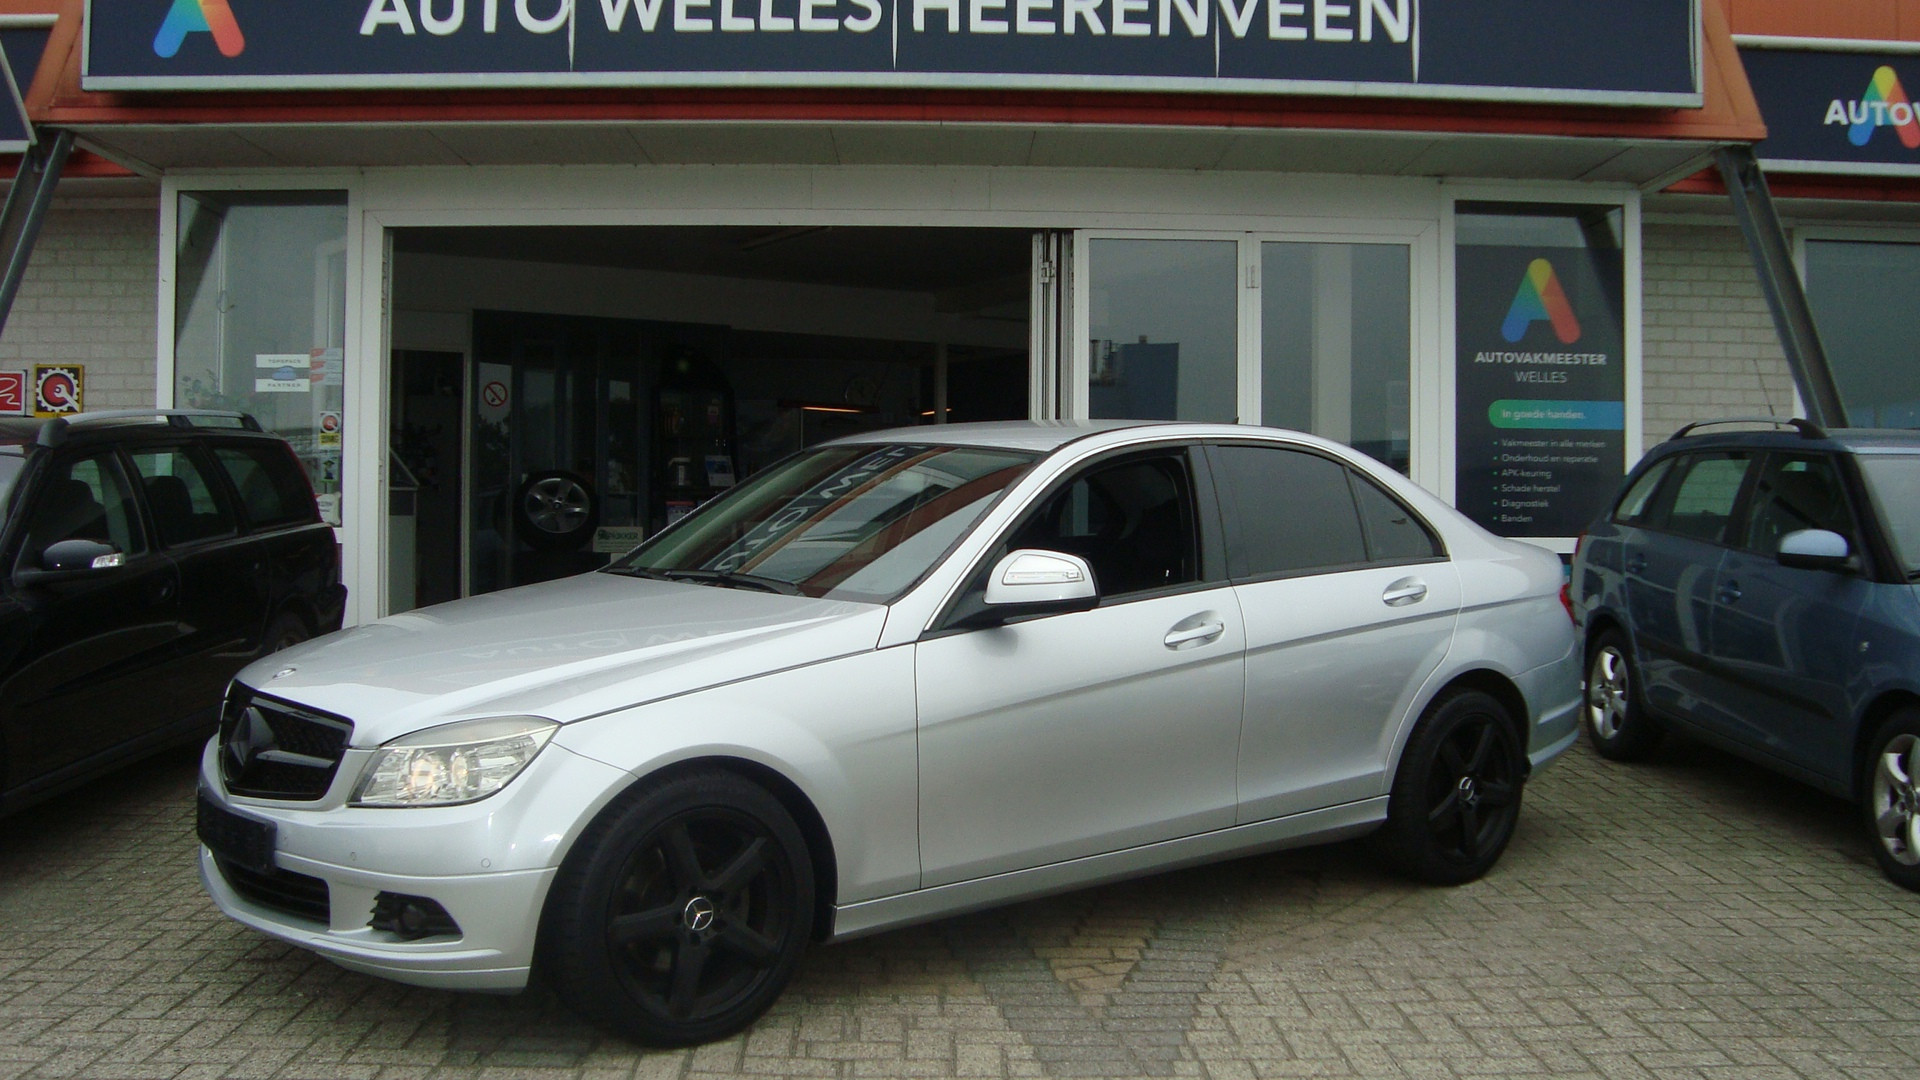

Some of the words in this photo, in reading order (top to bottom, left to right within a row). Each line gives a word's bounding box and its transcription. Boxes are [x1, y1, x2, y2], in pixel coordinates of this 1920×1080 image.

[359, 0, 570, 36] AUTO
[600, 0, 884, 33] WELLES
[911, 0, 1411, 44] HEERENVEEN
[1474, 351, 1608, 366] AUTOVAKMEESTER
[1515, 370, 1569, 384] WELLES
[1514, 409, 1545, 421] goede
[1501, 453, 1550, 463] Onderhoud
[1501, 483, 1532, 493] Schade
[1501, 498, 1549, 510] Diagnostiek
[1501, 514, 1534, 523] Banden
